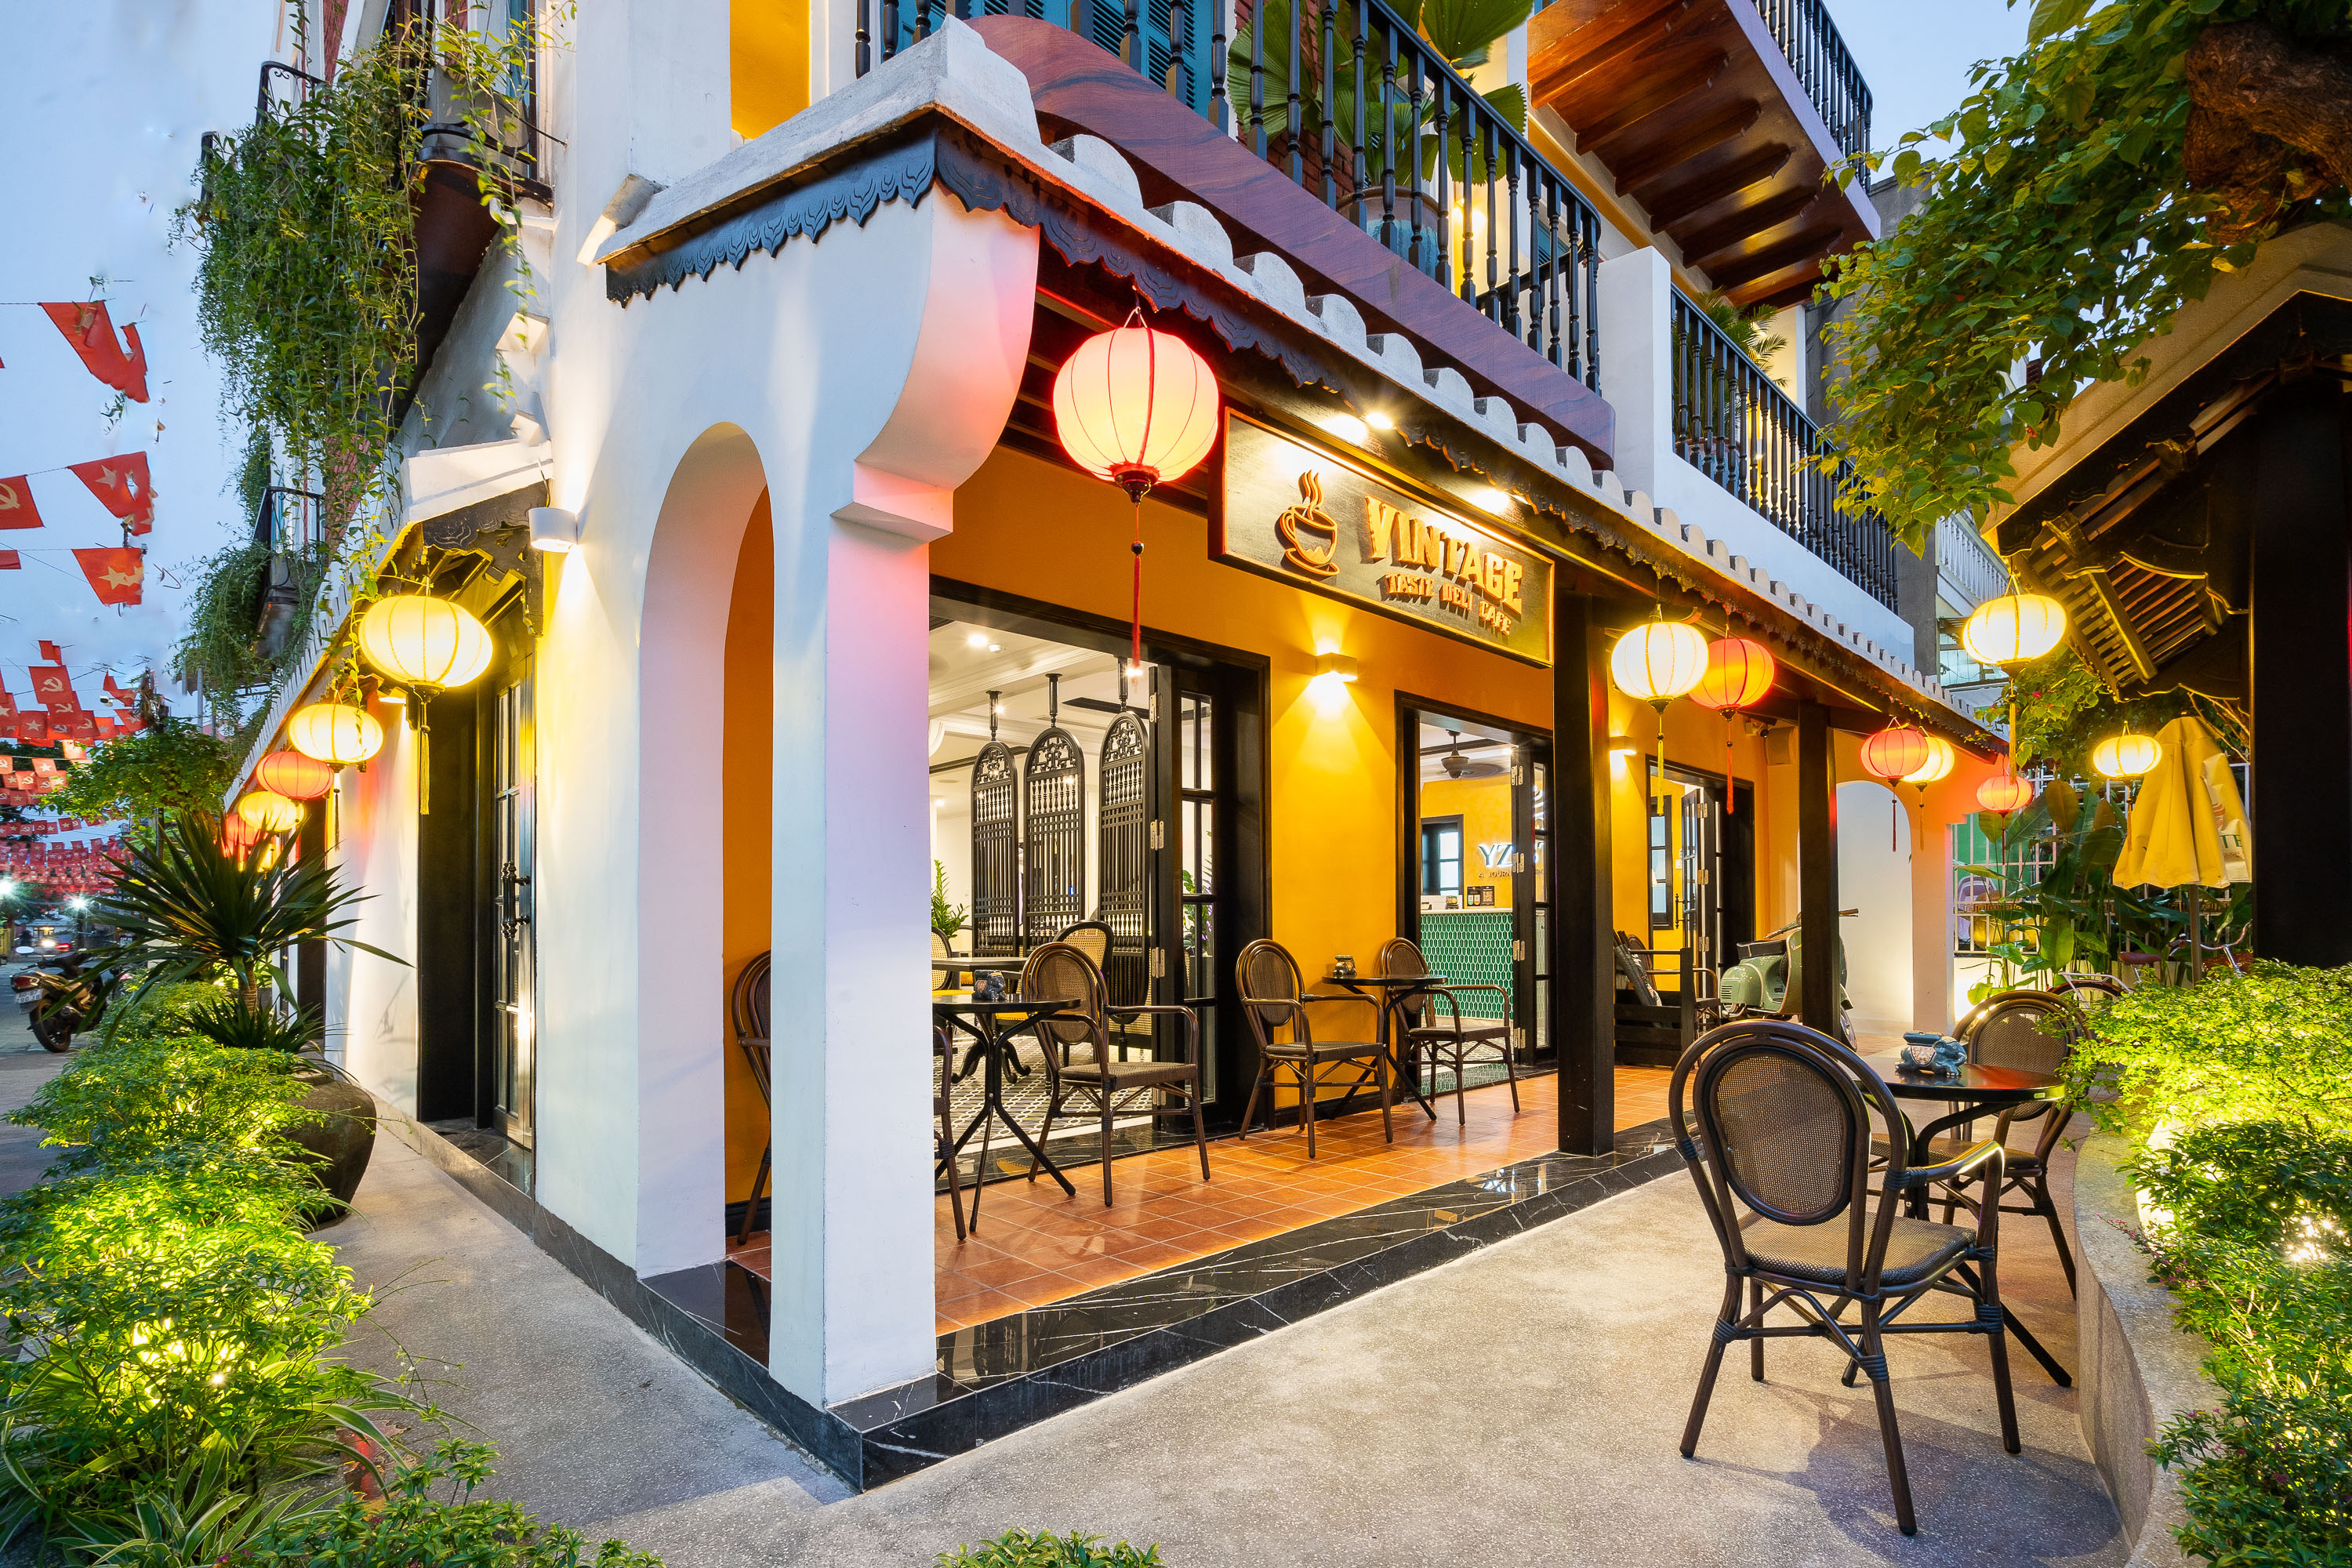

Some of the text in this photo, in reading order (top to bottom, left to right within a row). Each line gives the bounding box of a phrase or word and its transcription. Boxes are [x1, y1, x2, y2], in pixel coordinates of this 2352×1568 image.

[1365, 495, 1523, 615] VINTAGE
[1385, 572, 1512, 636] TASTE DELI CAFE
